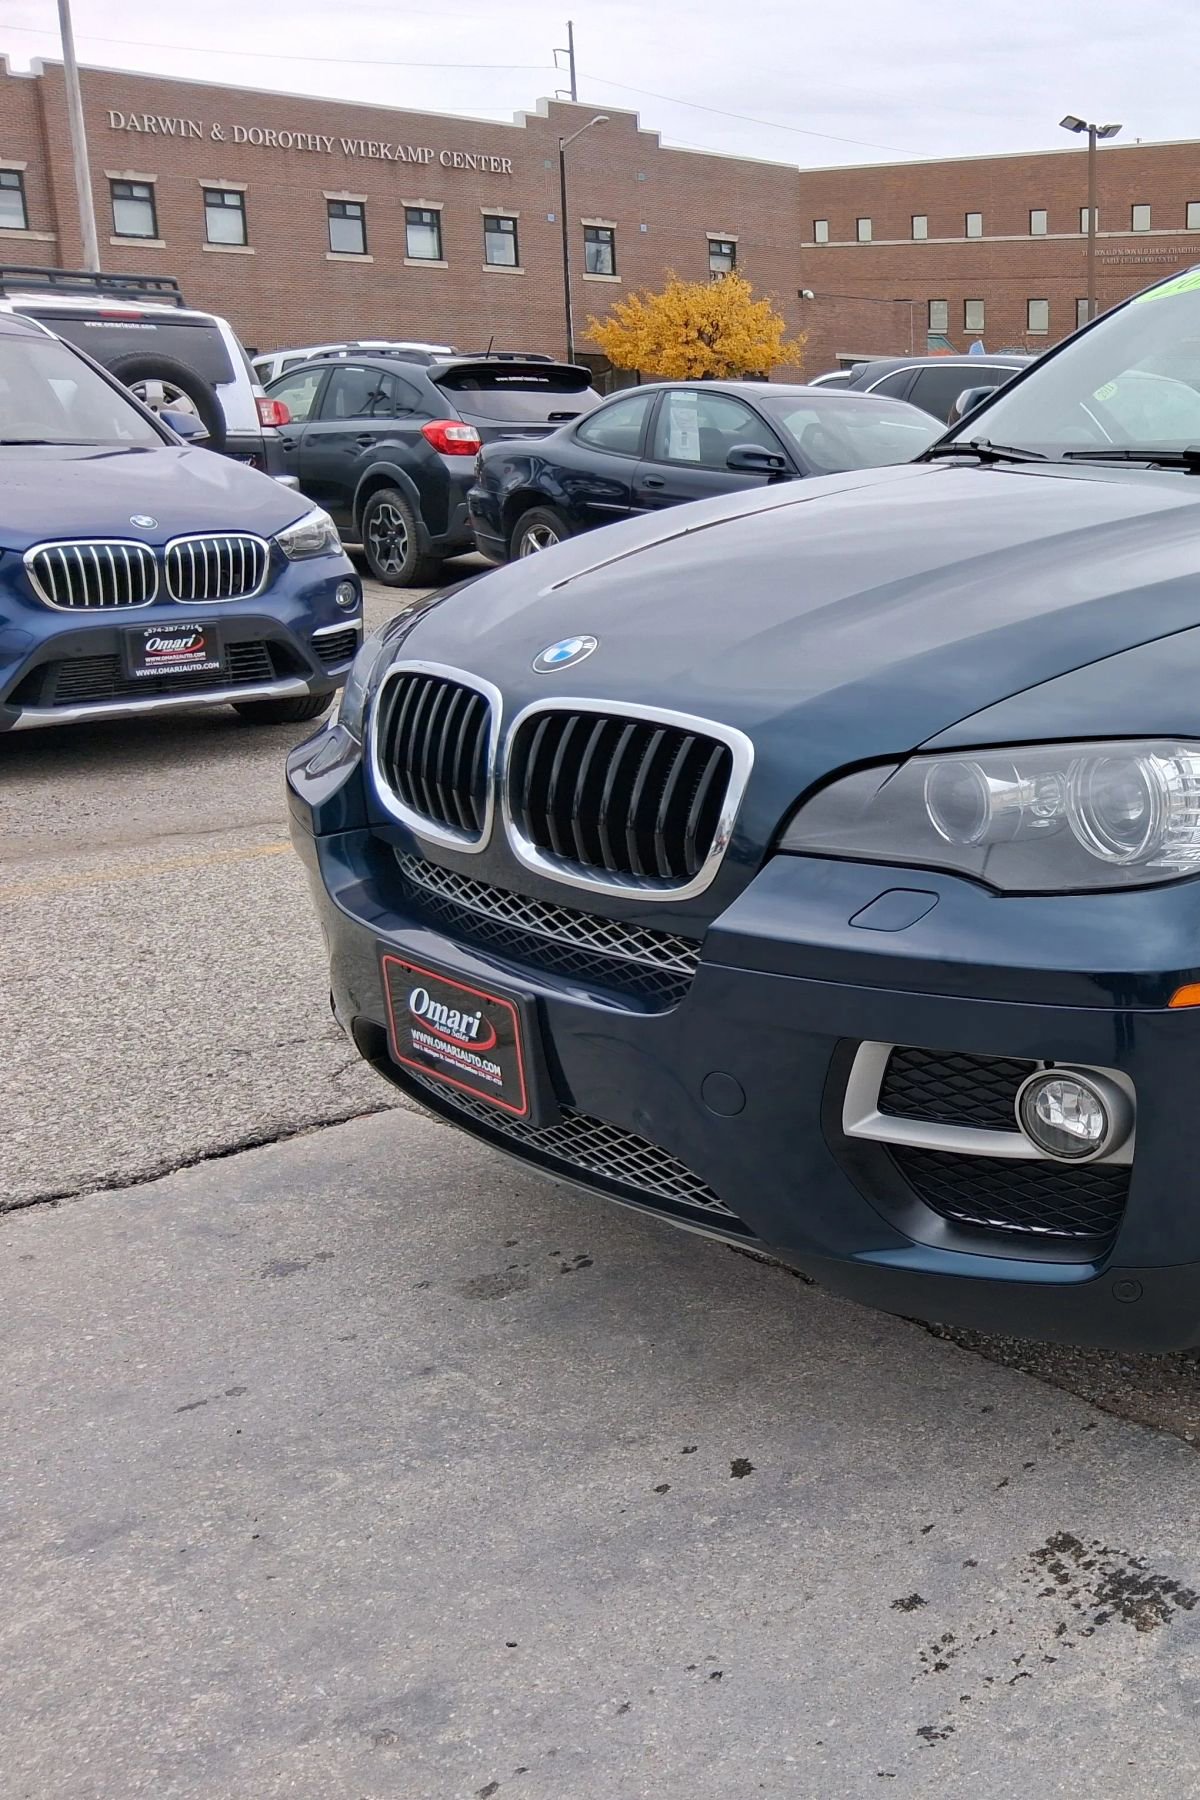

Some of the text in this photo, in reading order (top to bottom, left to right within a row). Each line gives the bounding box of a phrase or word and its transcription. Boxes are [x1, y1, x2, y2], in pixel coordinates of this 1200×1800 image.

[108, 110, 513, 174] DARWIN & DOROTHY WIEKAMP CENTER
[145, 634, 196, 651] Omari
[136, 662, 219, 676] WWW.OMARIAUTO.COM
[410, 988, 481, 1037] Omari
[411, 1028, 502, 1076] WWW.OMARIAUTO.COM
